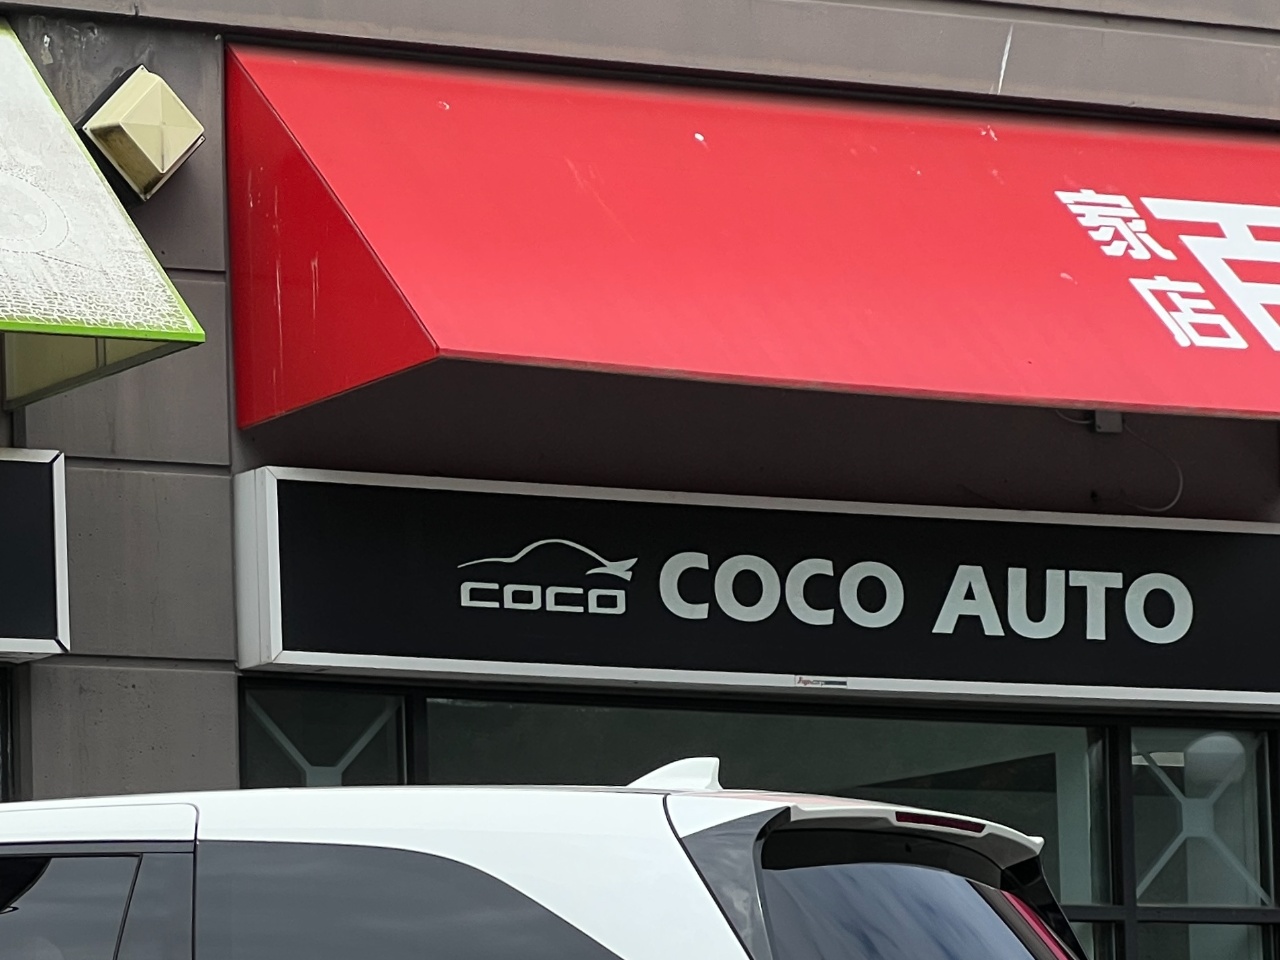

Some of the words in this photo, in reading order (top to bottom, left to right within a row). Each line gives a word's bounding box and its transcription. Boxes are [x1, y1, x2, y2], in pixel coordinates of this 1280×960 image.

[460, 581, 626, 615] COCO
[659, 551, 905, 628] COCO
[931, 564, 1194, 644] AUTO
